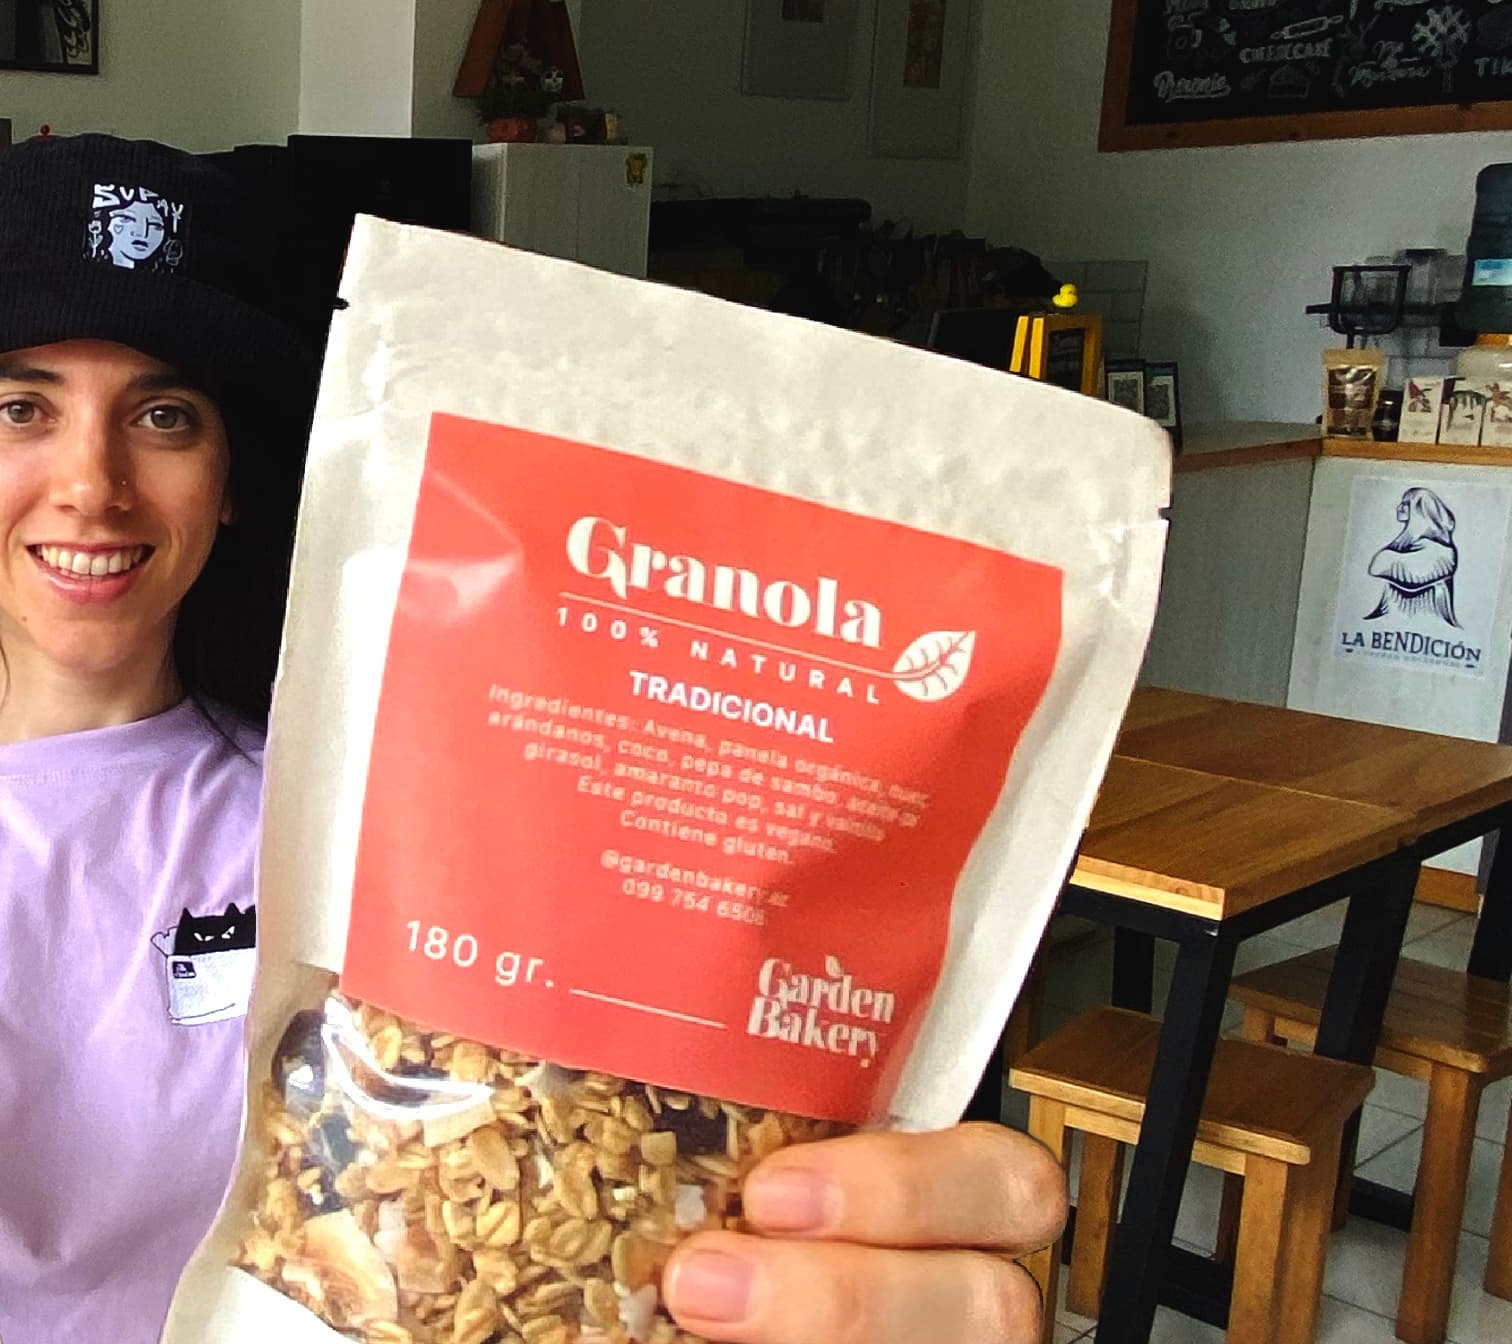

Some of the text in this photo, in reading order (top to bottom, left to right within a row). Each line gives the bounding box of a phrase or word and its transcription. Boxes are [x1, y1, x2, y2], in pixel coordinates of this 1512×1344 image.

[564, 514, 882, 652] Granola
[555, 605, 882, 705] 100% NATURAL
[1341, 631, 1365, 649] LA
[1371, 631, 1482, 664] BENDICIÓN
[628, 669, 835, 743] TRADICIONAL
[681, 753, 732, 780] pepa
[738, 766, 765, 787] de
[718, 739, 789, 771] panela
[576, 774, 626, 804] Este
[630, 786, 729, 826] producto
[734, 811, 760, 833] es
[613, 763, 717, 799] amaranto
[774, 800, 806, 821] sal
[619, 809, 718, 847] Contiene
[622, 878, 665, 905] 099
[671, 888, 711, 914] 754
[404, 919, 556, 989] 180 gr.
[758, 958, 896, 1025] Garden
[747, 995, 880, 1069] Bakery
